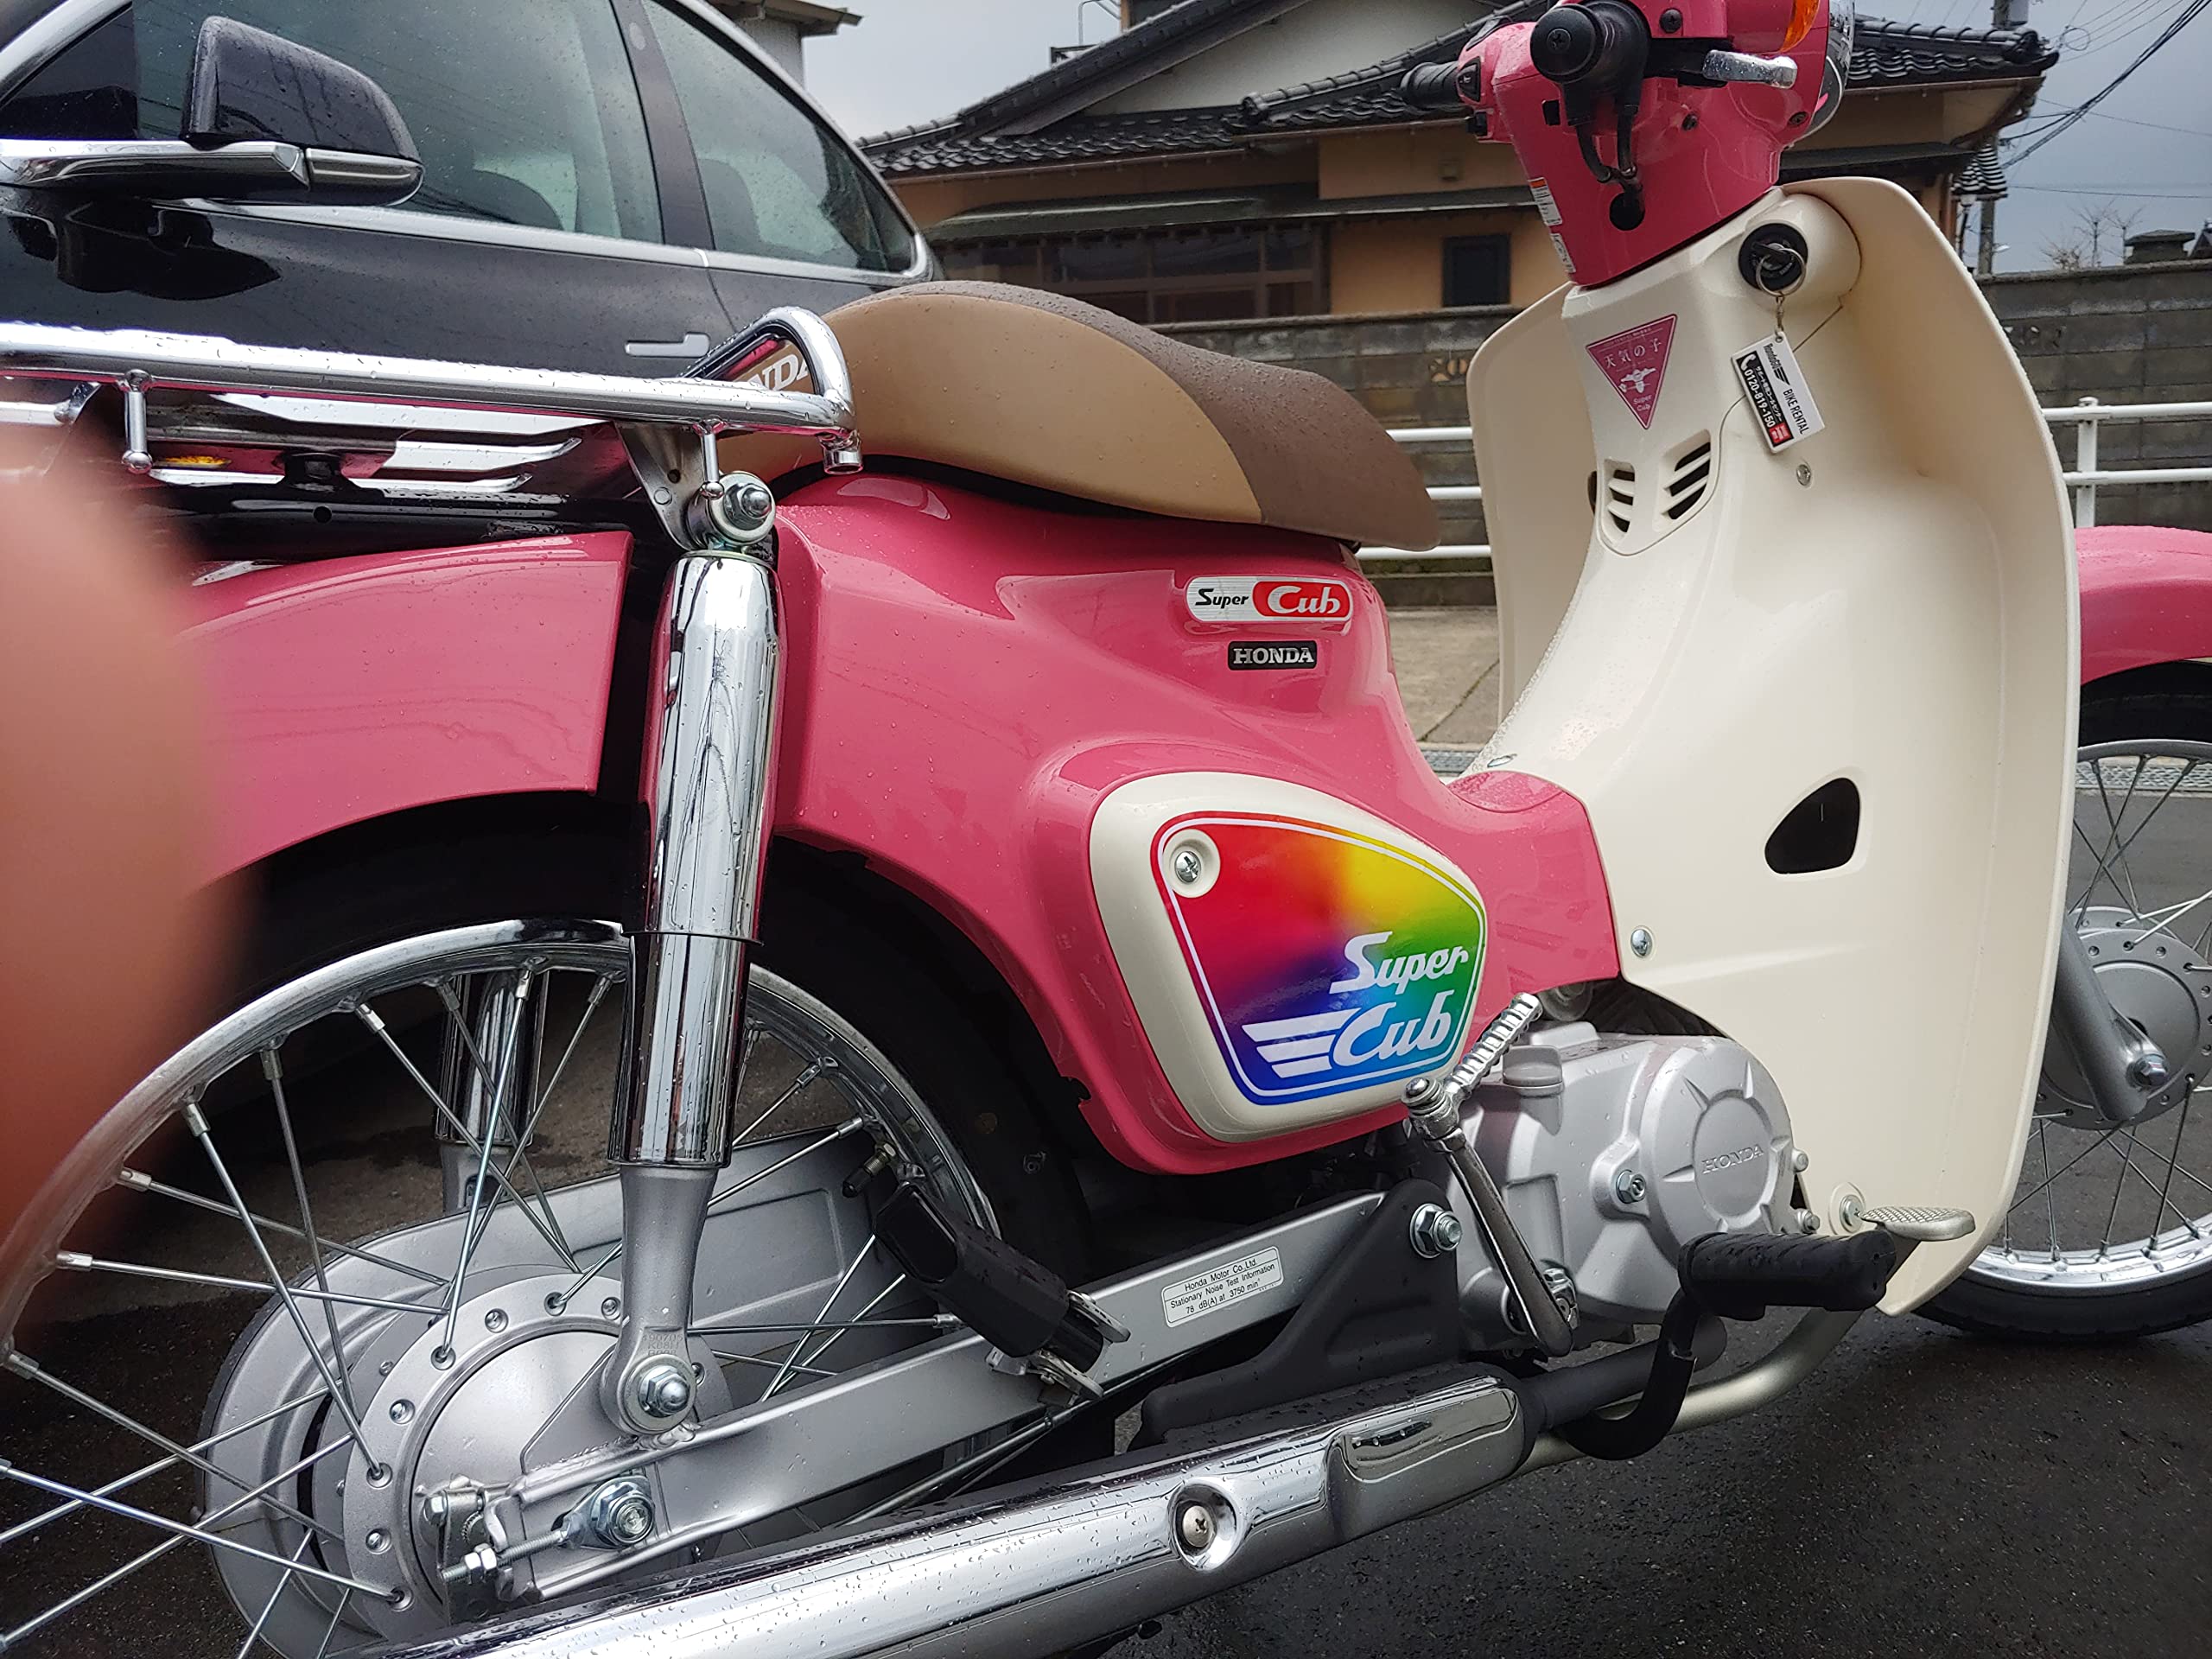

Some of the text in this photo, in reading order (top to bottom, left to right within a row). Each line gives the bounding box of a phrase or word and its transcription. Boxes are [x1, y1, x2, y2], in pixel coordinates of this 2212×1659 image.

[1744, 369, 1776, 428] 0120-819-150
[1783, 389, 1798, 408] BIKE
[1791, 404, 1810, 435] RENTAL
[1195, 585, 1341, 614] Super Cub
[1233, 647, 1314, 664] HONDA
[1329, 931, 1469, 995] Super
[1333, 989, 1454, 1066] Cub
[1701, 1143, 1764, 1174] HONDA
[1170, 1263, 1275, 1309] Stationary Noise Test Information
[1185, 1278, 1207, 1292] Honda
[1211, 1269, 1230, 1281] Motor
[1185, 1305, 1194, 1314] 78
[1198, 1296, 1217, 1309] dB(A)
[1219, 1294, 1225, 1302] at
[1229, 1285, 1245, 1298] 3750
